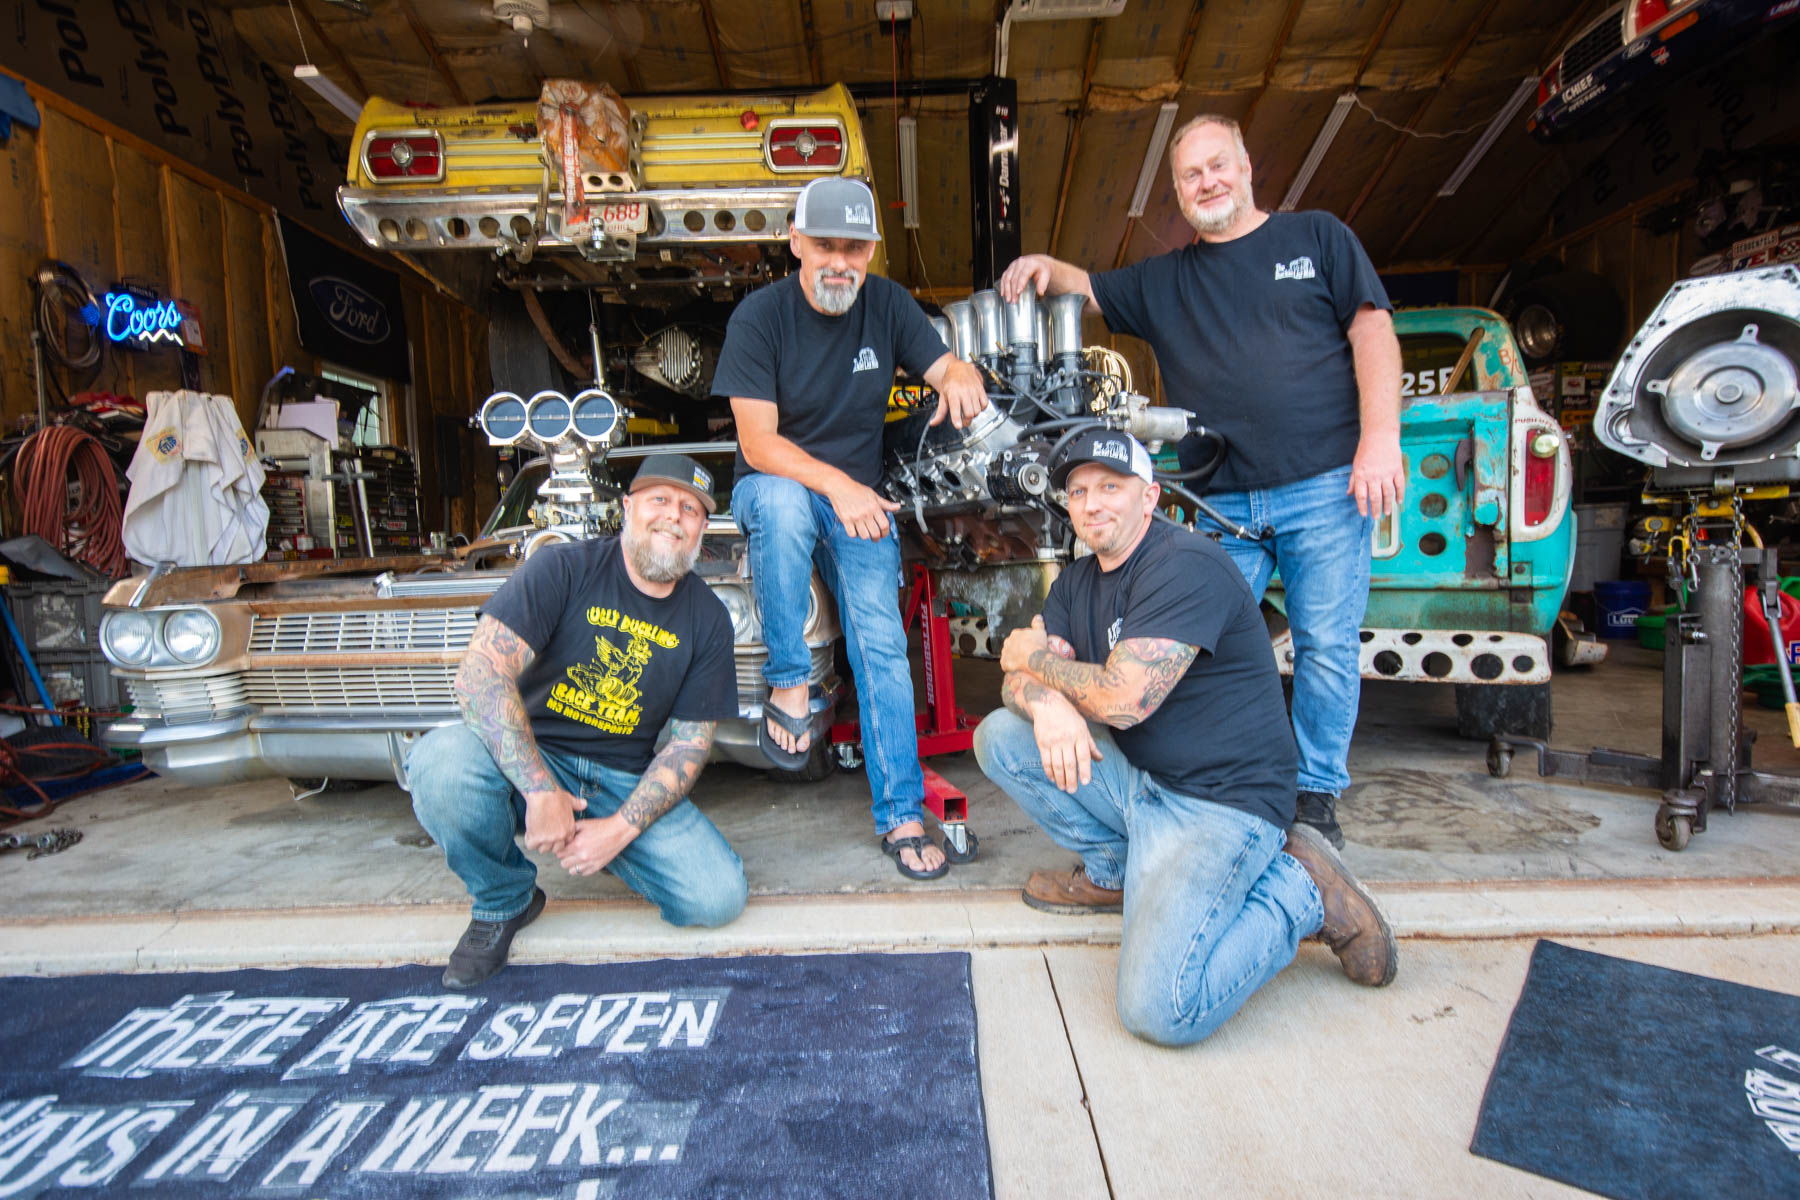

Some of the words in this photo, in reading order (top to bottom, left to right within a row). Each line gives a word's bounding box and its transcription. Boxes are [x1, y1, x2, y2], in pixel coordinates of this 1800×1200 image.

[999, 119, 1010, 188] Dannar
[603, 200, 641, 223] 688
[105, 292, 182, 341] Coors
[329, 285, 380, 335] Ford
[587, 605, 620, 628] UGLY
[619, 614, 680, 649] DUCKLING
[921, 602, 935, 706] PITTSBURGH
[546, 697, 564, 713] M3
[563, 705, 635, 736] MOTORSPORTS
[552, 682, 596, 711] RACE
[597, 700, 641, 725] TEAM
[261, 1102, 374, 1185] A
